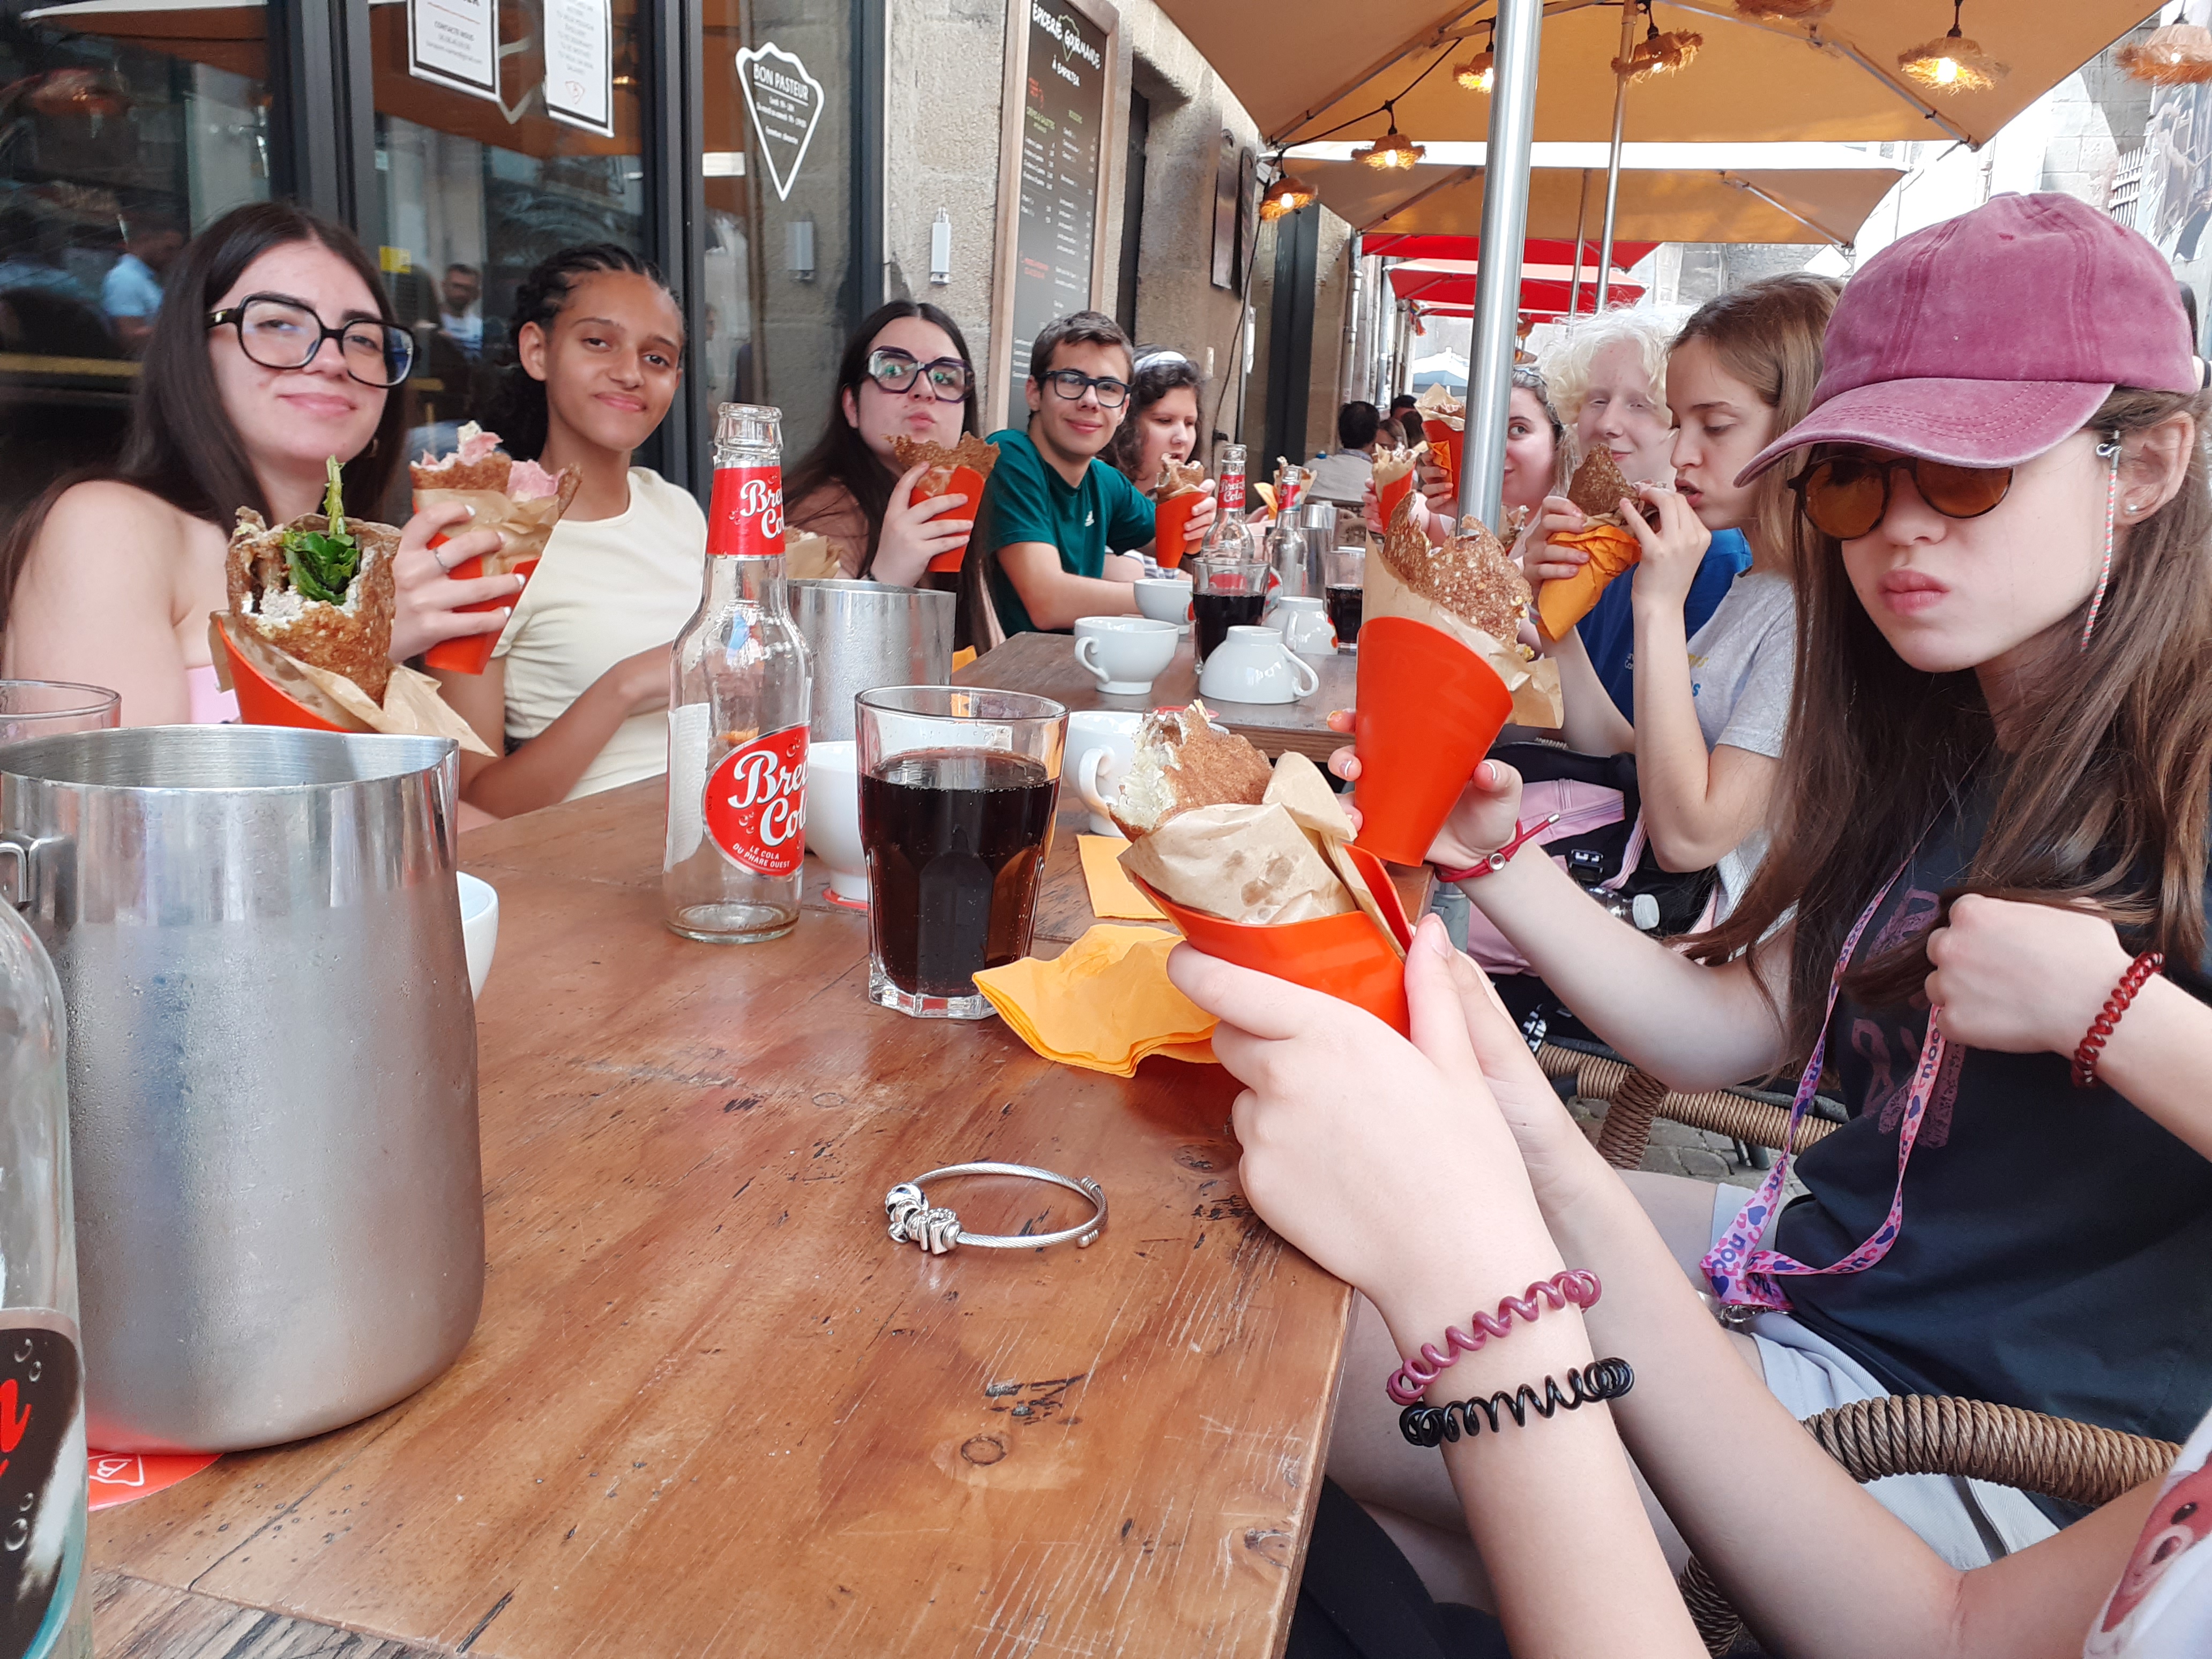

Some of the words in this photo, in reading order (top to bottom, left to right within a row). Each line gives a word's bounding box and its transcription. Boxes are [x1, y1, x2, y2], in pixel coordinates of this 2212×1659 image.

[753, 63, 773, 85] BON
[775, 72, 809, 101] PASTEUR
[740, 480, 782, 517] Bre
[727, 750, 809, 810] Brei
[733, 842, 744, 854] DU
[744, 851, 768, 867] PHARE
[770, 860, 790, 868] OUEST
[750, 845, 760, 855] LE
[761, 850, 780, 860] COLA
